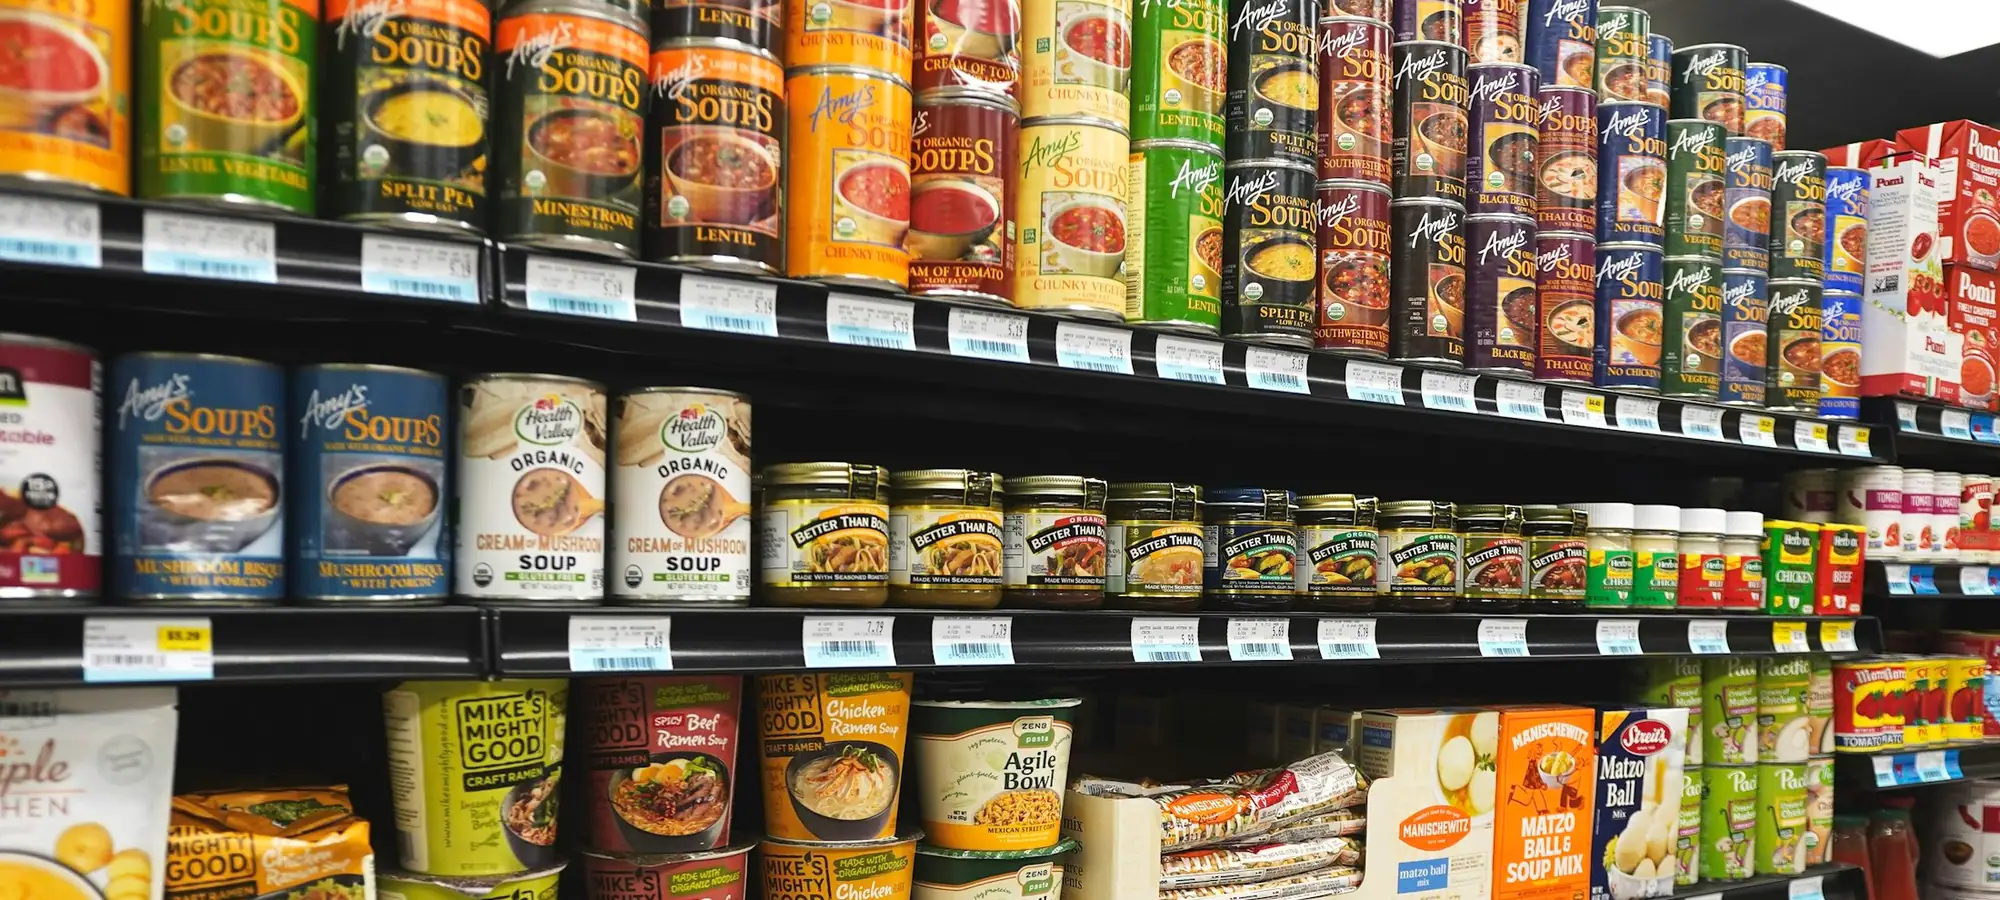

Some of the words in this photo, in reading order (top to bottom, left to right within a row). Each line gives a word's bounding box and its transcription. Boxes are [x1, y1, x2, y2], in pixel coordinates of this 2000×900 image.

[1231, 0, 1291, 42] Amy's
[371, 20, 482, 80] SOUPS
[507, 20, 576, 81] Amy's
[1319, 26, 1370, 59] Amy's
[651, 55, 706, 99] Amy's
[1394, 49, 1449, 90] Amy's
[1682, 50, 1729, 84] Amy's
[538, 52, 641, 110] SOUPS
[700, 84, 754, 98] ORGANIC
[1468, 71, 1520, 111] Amy's
[675, 84, 773, 133] SOUPS
[811, 84, 876, 133] Amy's
[1159, 113, 1201, 128] LENTIL
[1601, 108, 1651, 145] Amy's
[923, 136, 973, 148] ORGANIC
[1270, 131, 1303, 148] SPLIT
[1669, 126, 1717, 161] Amy's
[1023, 130, 1082, 179] Amy's
[1053, 156, 1128, 198] SOUPS
[1168, 158, 1219, 199] Amy's
[1771, 158, 1816, 191] Amy's
[381, 180, 437, 201] SPLIT
[444, 186, 474, 210] PEA
[1224, 170, 1280, 216] Amy's
[1479, 193, 1509, 205] BLACK
[1826, 175, 1865, 202] Amy's
[1273, 195, 1309, 209] ORGANIC
[1251, 194, 1317, 234] SOUPS
[1353, 217, 1387, 230] ORGANIC
[1538, 212, 1566, 222] THAI
[696, 227, 756, 247] LENTIL
[1408, 211, 1459, 249] Amy's
[1614, 223, 1631, 234] NO
[825, 245, 875, 260] CHUNKY
[1477, 228, 1528, 266] Amy's
[932, 266, 950, 278] OF
[952, 265, 1004, 281] TOMATO
[1595, 252, 1645, 289] Amy's
[1034, 278, 1088, 292] CHUNKY
[1665, 266, 1713, 300] Amy's
[1767, 288, 1811, 315] Amy's
[892, 319, 910, 332] 5.19
[1260, 306, 1295, 320] SPLIT
[1297, 309, 1314, 325] PEA
[1008, 323, 1024, 338] 5.19
[1314, 327, 1379, 340] SOUTHWESTERN
[1109, 346, 1124, 360] 5.19
[1491, 347, 1519, 360] BLACK
[1207, 358, 1222, 371] 5.19
[1544, 359, 1571, 370] THAI
[1607, 366, 1623, 377] NO
[1624, 367, 1658, 379] CHICKEN
[118, 373, 195, 430] Amy's
[301, 383, 372, 439] Amy's
[165, 399, 276, 439] SOUPS
[524, 405, 573, 425] Health
[671, 413, 716, 433] Health
[345, 408, 441, 446] SOUPS
[534, 422, 577, 440] Valley
[680, 429, 722, 448] Valley
[511, 449, 585, 475] ORGANIC
[657, 457, 728, 480] ORGANIC
[794, 517, 838, 545] BETTER
[840, 515, 870, 529] THAN
[914, 524, 956, 549] BETTER
[957, 520, 986, 534] THAN
[1030, 529, 1071, 551] BETTER
[1072, 524, 1096, 536] THAN
[477, 534, 525, 550] CREAM
[628, 537, 671, 553] CREAM
[684, 536, 748, 555] MUSHROOM
[1130, 539, 1168, 560] BETTER
[1171, 535, 1193, 546] THAN
[1225, 537, 1262, 558] BETTER
[1265, 533, 1286, 545] THAN
[1312, 542, 1348, 562] BETTER
[1349, 539, 1370, 550] THAN
[1394, 544, 1429, 564] BETTER
[1430, 541, 1449, 552] THAN
[518, 554, 577, 570] SOUP
[666, 556, 721, 571] SOUP
[1466, 548, 1500, 567] BETTER
[1501, 545, 1519, 556] THAN
[1532, 551, 1565, 569] BETTER
[1565, 548, 1582, 559] THAN
[912, 576, 931, 584] MADE
[951, 577, 982, 585] SEASONED
[1775, 569, 1814, 585] CHICKEN
[1832, 570, 1854, 584] BEEF
[866, 620, 885, 634] 7.79
[991, 623, 1008, 638] 7.79
[1181, 634, 1195, 646] 5.99
[761, 673, 813, 693] MIKE'S
[828, 682, 869, 694] ORGANIC
[464, 693, 543, 723] MIKE'S
[762, 694, 814, 711] MIGHTY
[826, 699, 886, 719] Chicken
[465, 716, 541, 744] MIGHTY
[654, 715, 683, 727] SPICY
[686, 713, 719, 732] Beef
[764, 709, 818, 733] GOOD
[831, 719, 877, 736] Ramen
[879, 722, 900, 737] Soup
[657, 729, 707, 748] Ramen
[707, 732, 729, 750] Soup
[786, 741, 822, 752] RAMEN
[1025, 733, 1050, 745] pasta
[1511, 721, 1590, 751] MANISCHEWITZ
[1622, 724, 1669, 748] Streit's
[468, 734, 541, 764] GOOD
[1003, 751, 1057, 775] Agile
[1600, 754, 1644, 780] Matzo
[467, 773, 505, 788] CRAFT
[507, 767, 543, 783] RAMEN
[1003, 768, 1055, 791] Bowl
[1606, 780, 1635, 808] Ball
[1521, 812, 1576, 837] MATZO
[1612, 809, 1627, 819] Mix
[987, 825, 1020, 835] MEXICAN
[1402, 815, 1470, 838] MANISCHEWITZ
[261, 844, 333, 869] Chicken
[1523, 836, 1562, 859] BALL
[167, 852, 249, 882] GOOD
[767, 857, 823, 877] MIKE'S
[838, 865, 876, 879] ORGANIC
[876, 859, 908, 873] NOODLES
[839, 857, 864, 868] MADE
[1399, 867, 1428, 882] matzo
[1429, 864, 1447, 878] ball
[1506, 858, 1552, 884] SOUP
[1553, 855, 1584, 877] MIX
[670, 880, 710, 894] ORGANIC
[672, 872, 698, 882] MADE
[768, 875, 825, 893] MIGHTY
[1028, 880, 1050, 892] pasta
[1416, 878, 1430, 888] mix
[836, 880, 893, 900] Chicken
